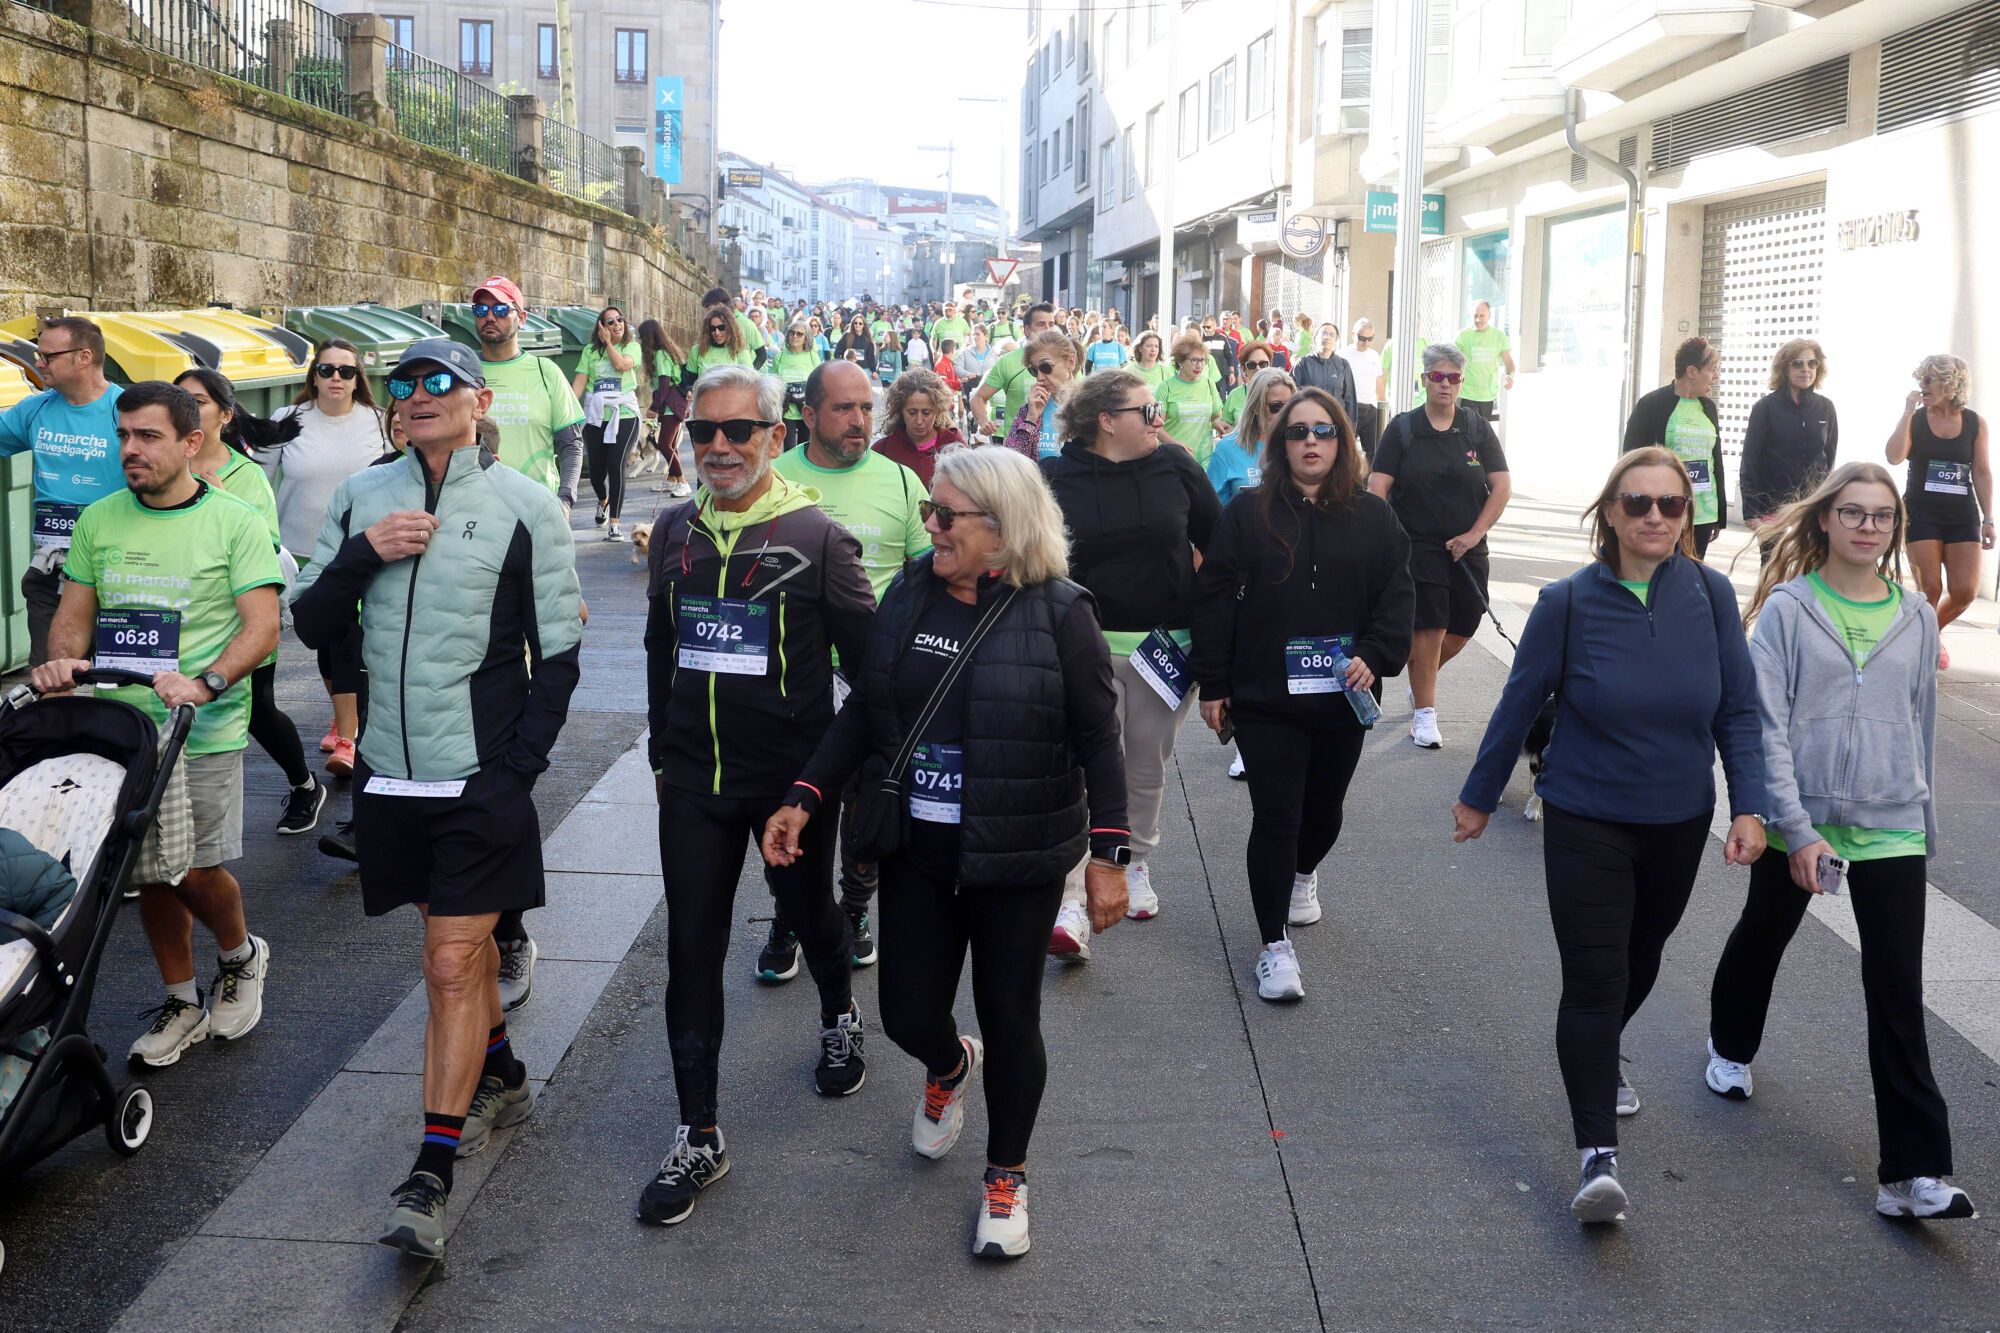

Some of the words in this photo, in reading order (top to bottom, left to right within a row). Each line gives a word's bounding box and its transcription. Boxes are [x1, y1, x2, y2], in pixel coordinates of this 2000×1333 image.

[37, 426, 54, 441] En
[54, 432, 108, 448] marcha
[1688, 470, 1700, 478] 07
[44, 517, 76, 530] 2599
[844, 522, 881, 536] rcha
[103, 569, 121, 583] En
[126, 574, 190, 590] marcha
[115, 629, 159, 645] 0628
[696, 621, 743, 641] 0742
[1153, 648, 1180, 680] 0807
[1301, 655, 1332, 668] 080
[913, 752, 926, 760] rcha
[915, 769, 962, 791] 0741
